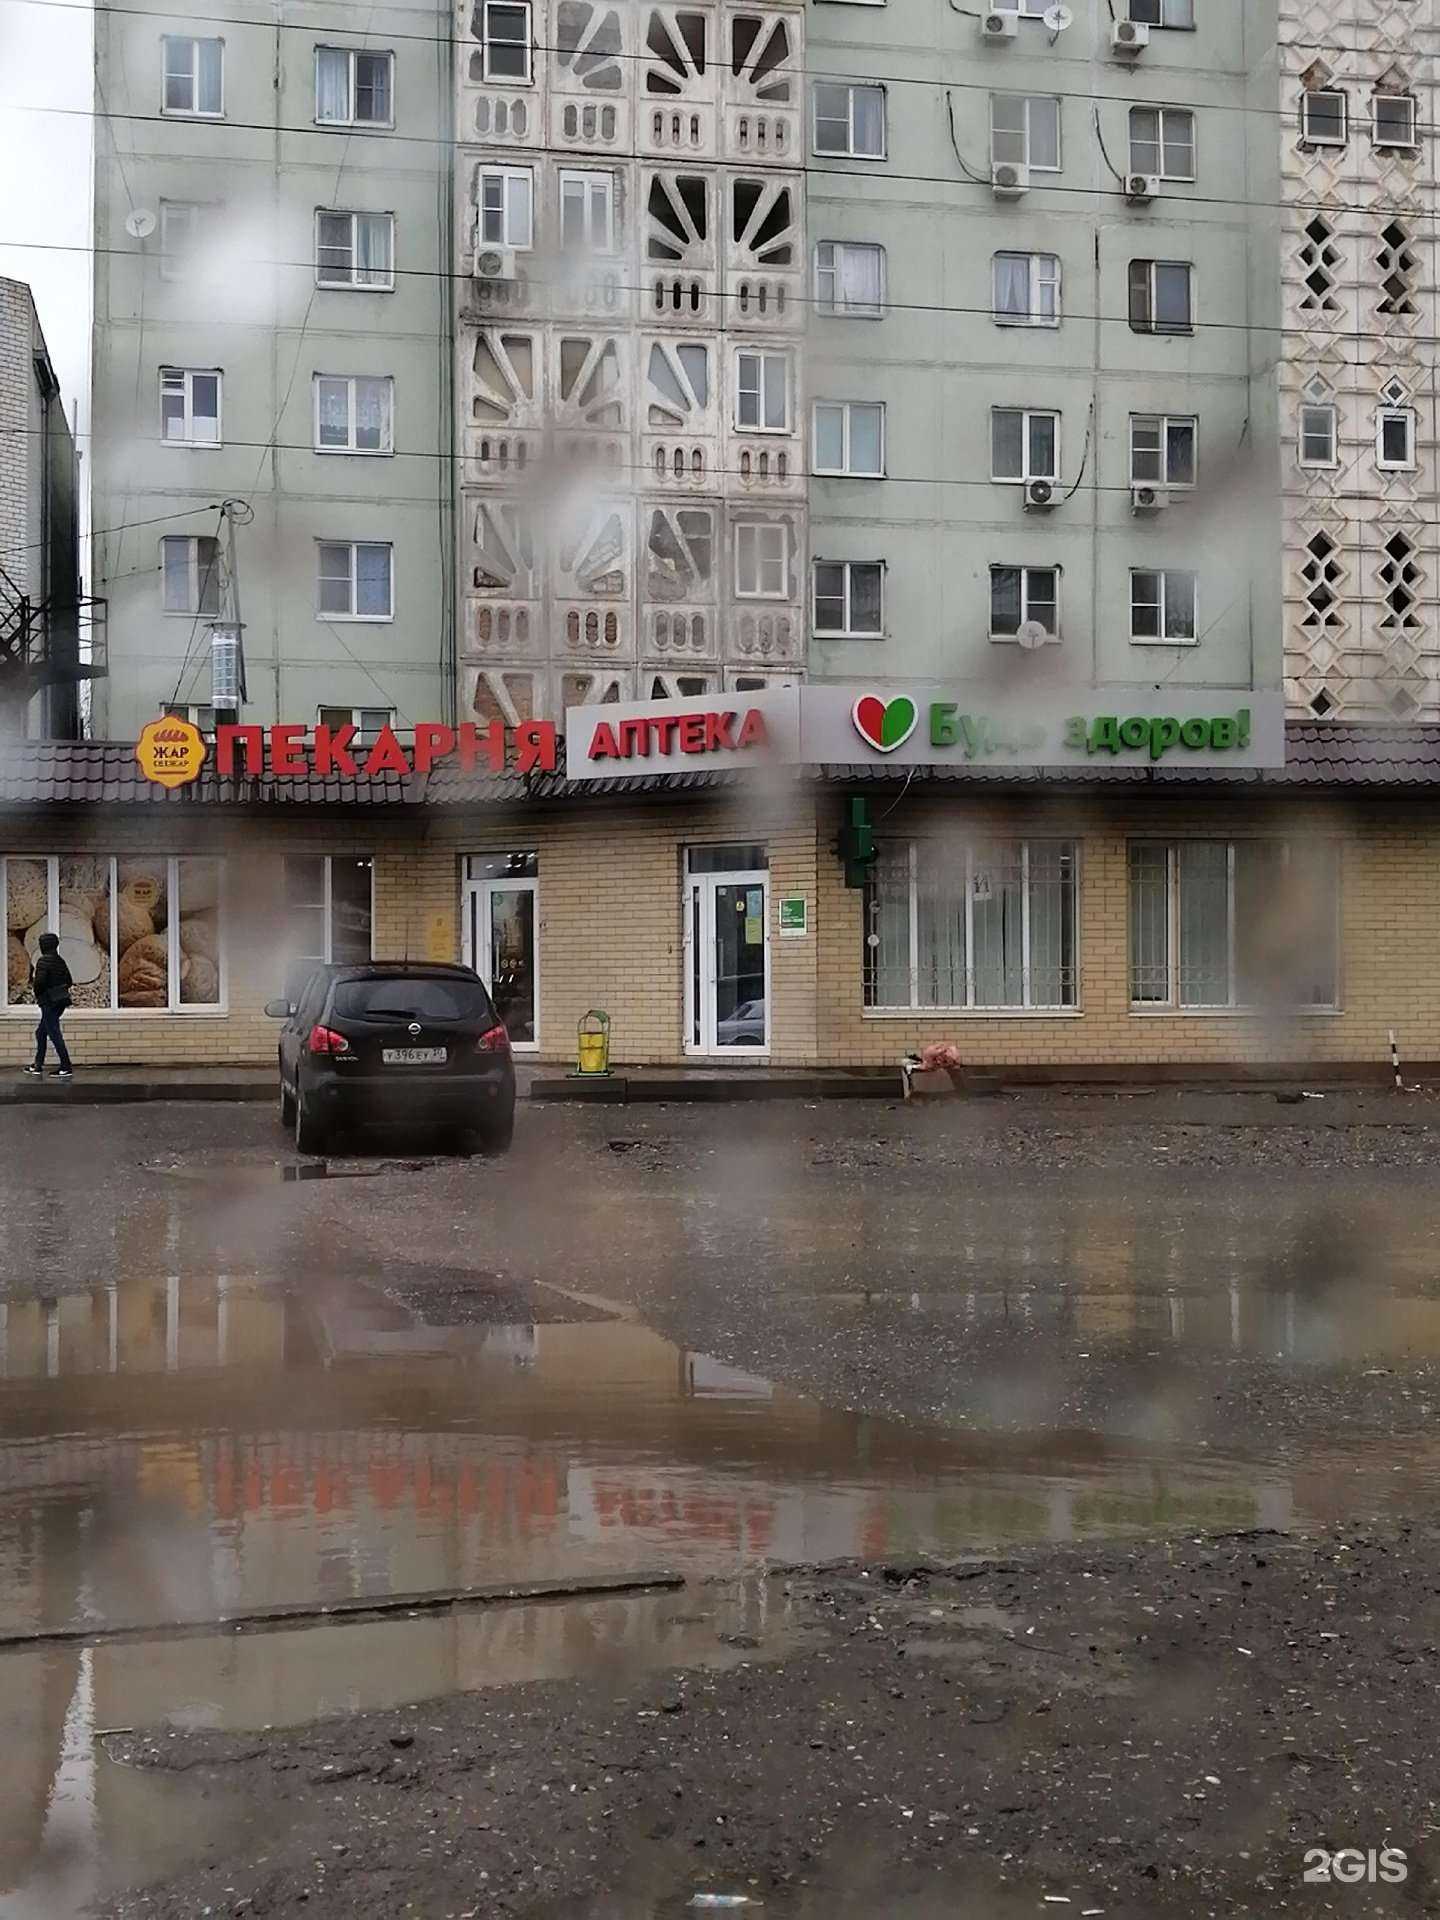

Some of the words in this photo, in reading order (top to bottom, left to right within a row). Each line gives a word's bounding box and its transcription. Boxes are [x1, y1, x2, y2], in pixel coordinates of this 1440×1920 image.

[153, 746, 190, 759] ЖАР
[215, 719, 557, 777] ПЕКАРНЯ
[587, 708, 770, 761] АПТЕКА
[1063, 708, 1251, 762] здоров!
